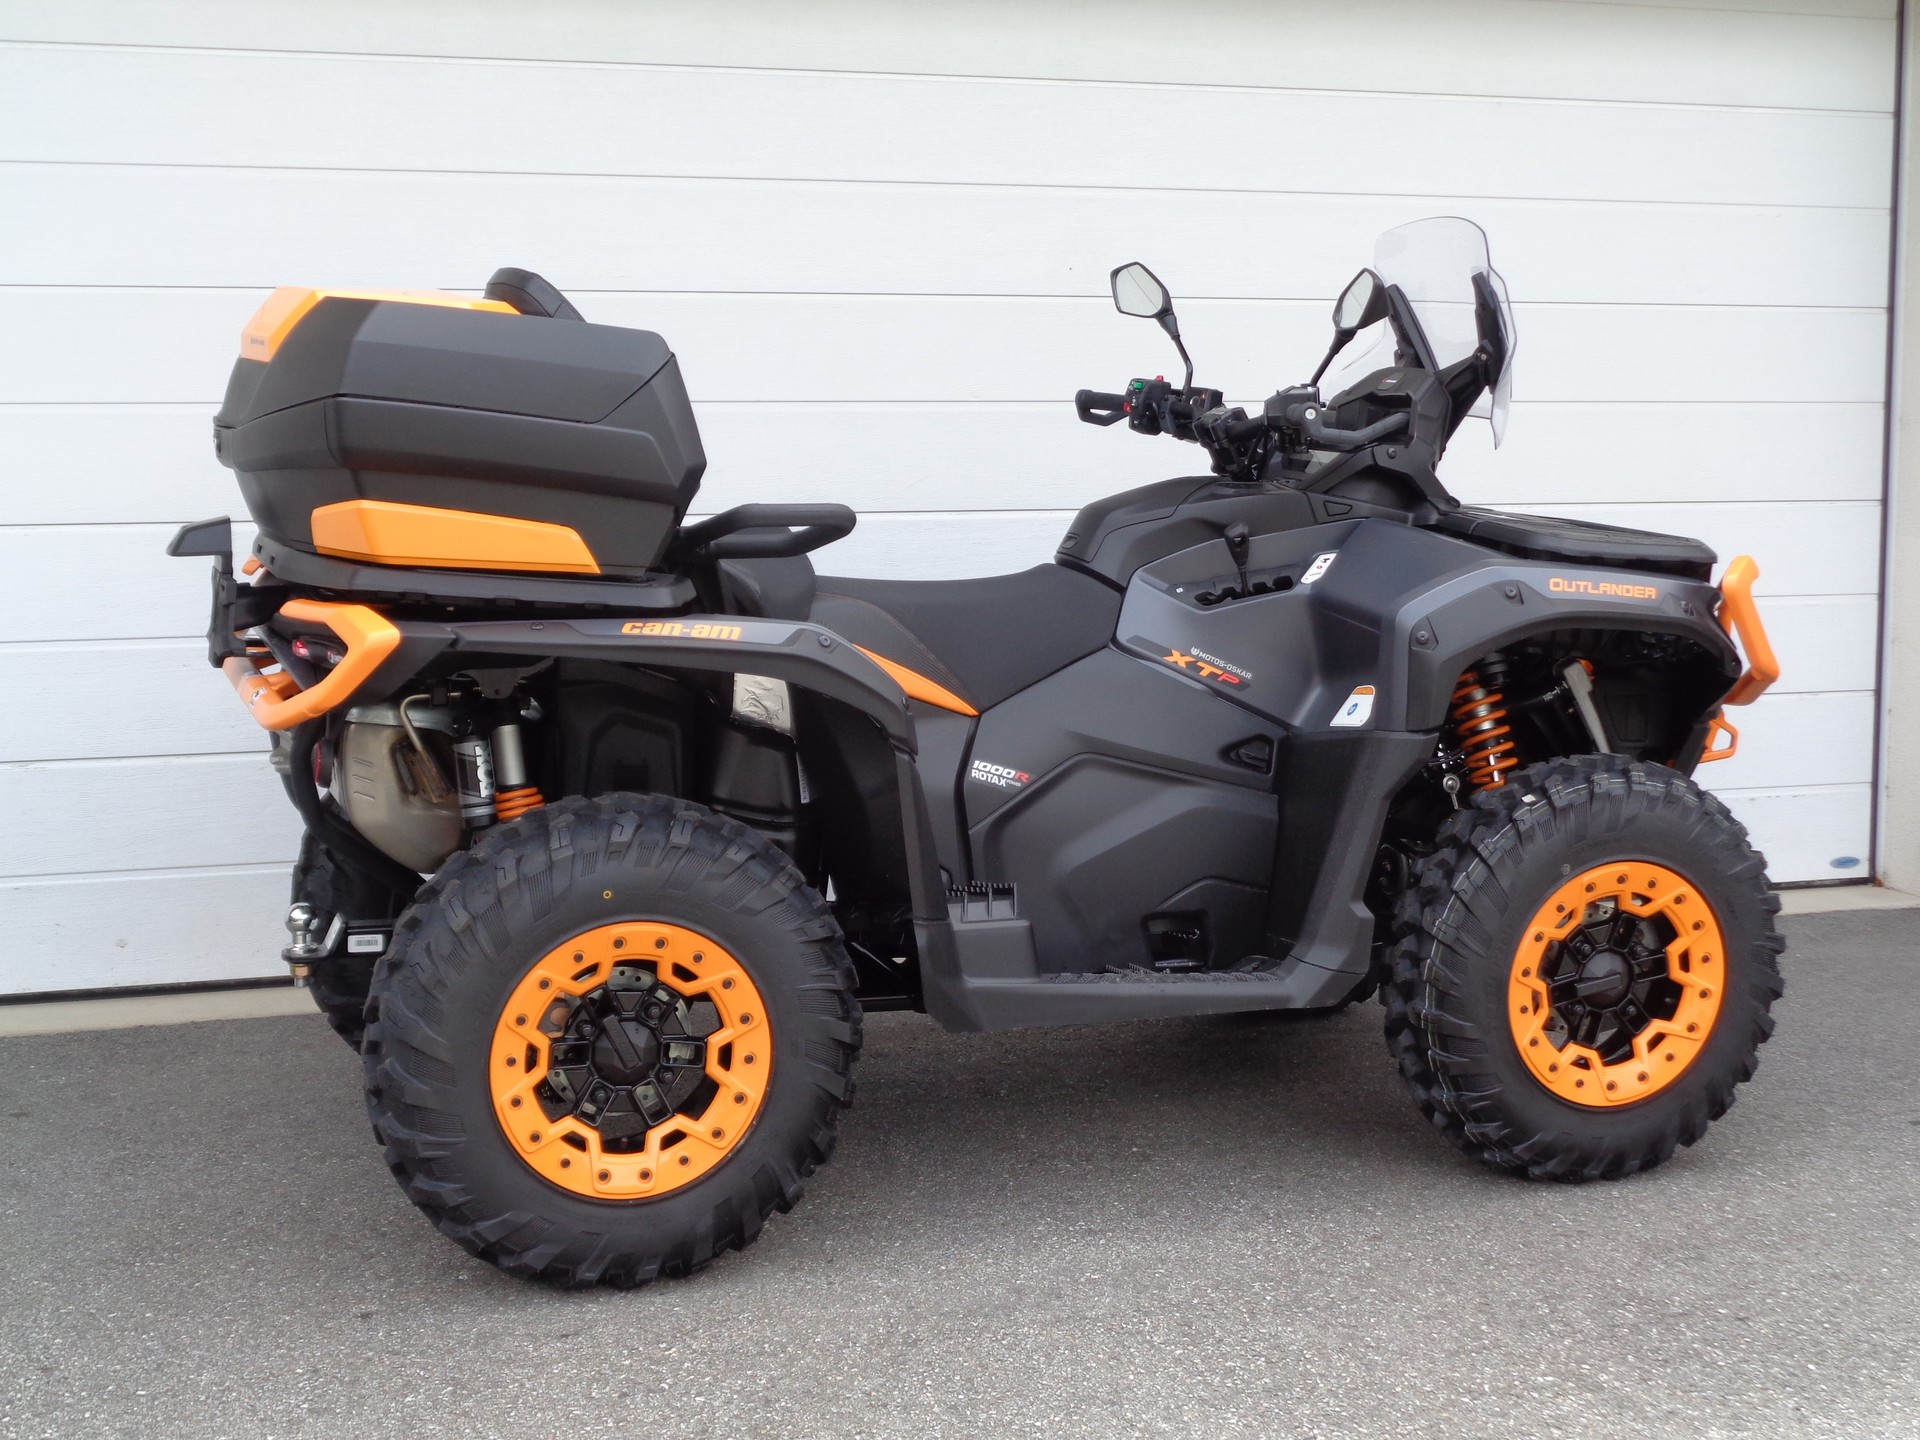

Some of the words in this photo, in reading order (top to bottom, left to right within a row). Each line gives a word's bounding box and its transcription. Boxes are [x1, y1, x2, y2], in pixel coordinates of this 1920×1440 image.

[1549, 577, 1656, 599] OUTLANDER
[621, 622, 742, 640] can-am
[1162, 649, 1242, 685] XTP
[1199, 651, 1252, 680] MOTOS-OSKAR
[971, 769, 1007, 787] ROTAX
[972, 760, 1030, 783] 1000R
